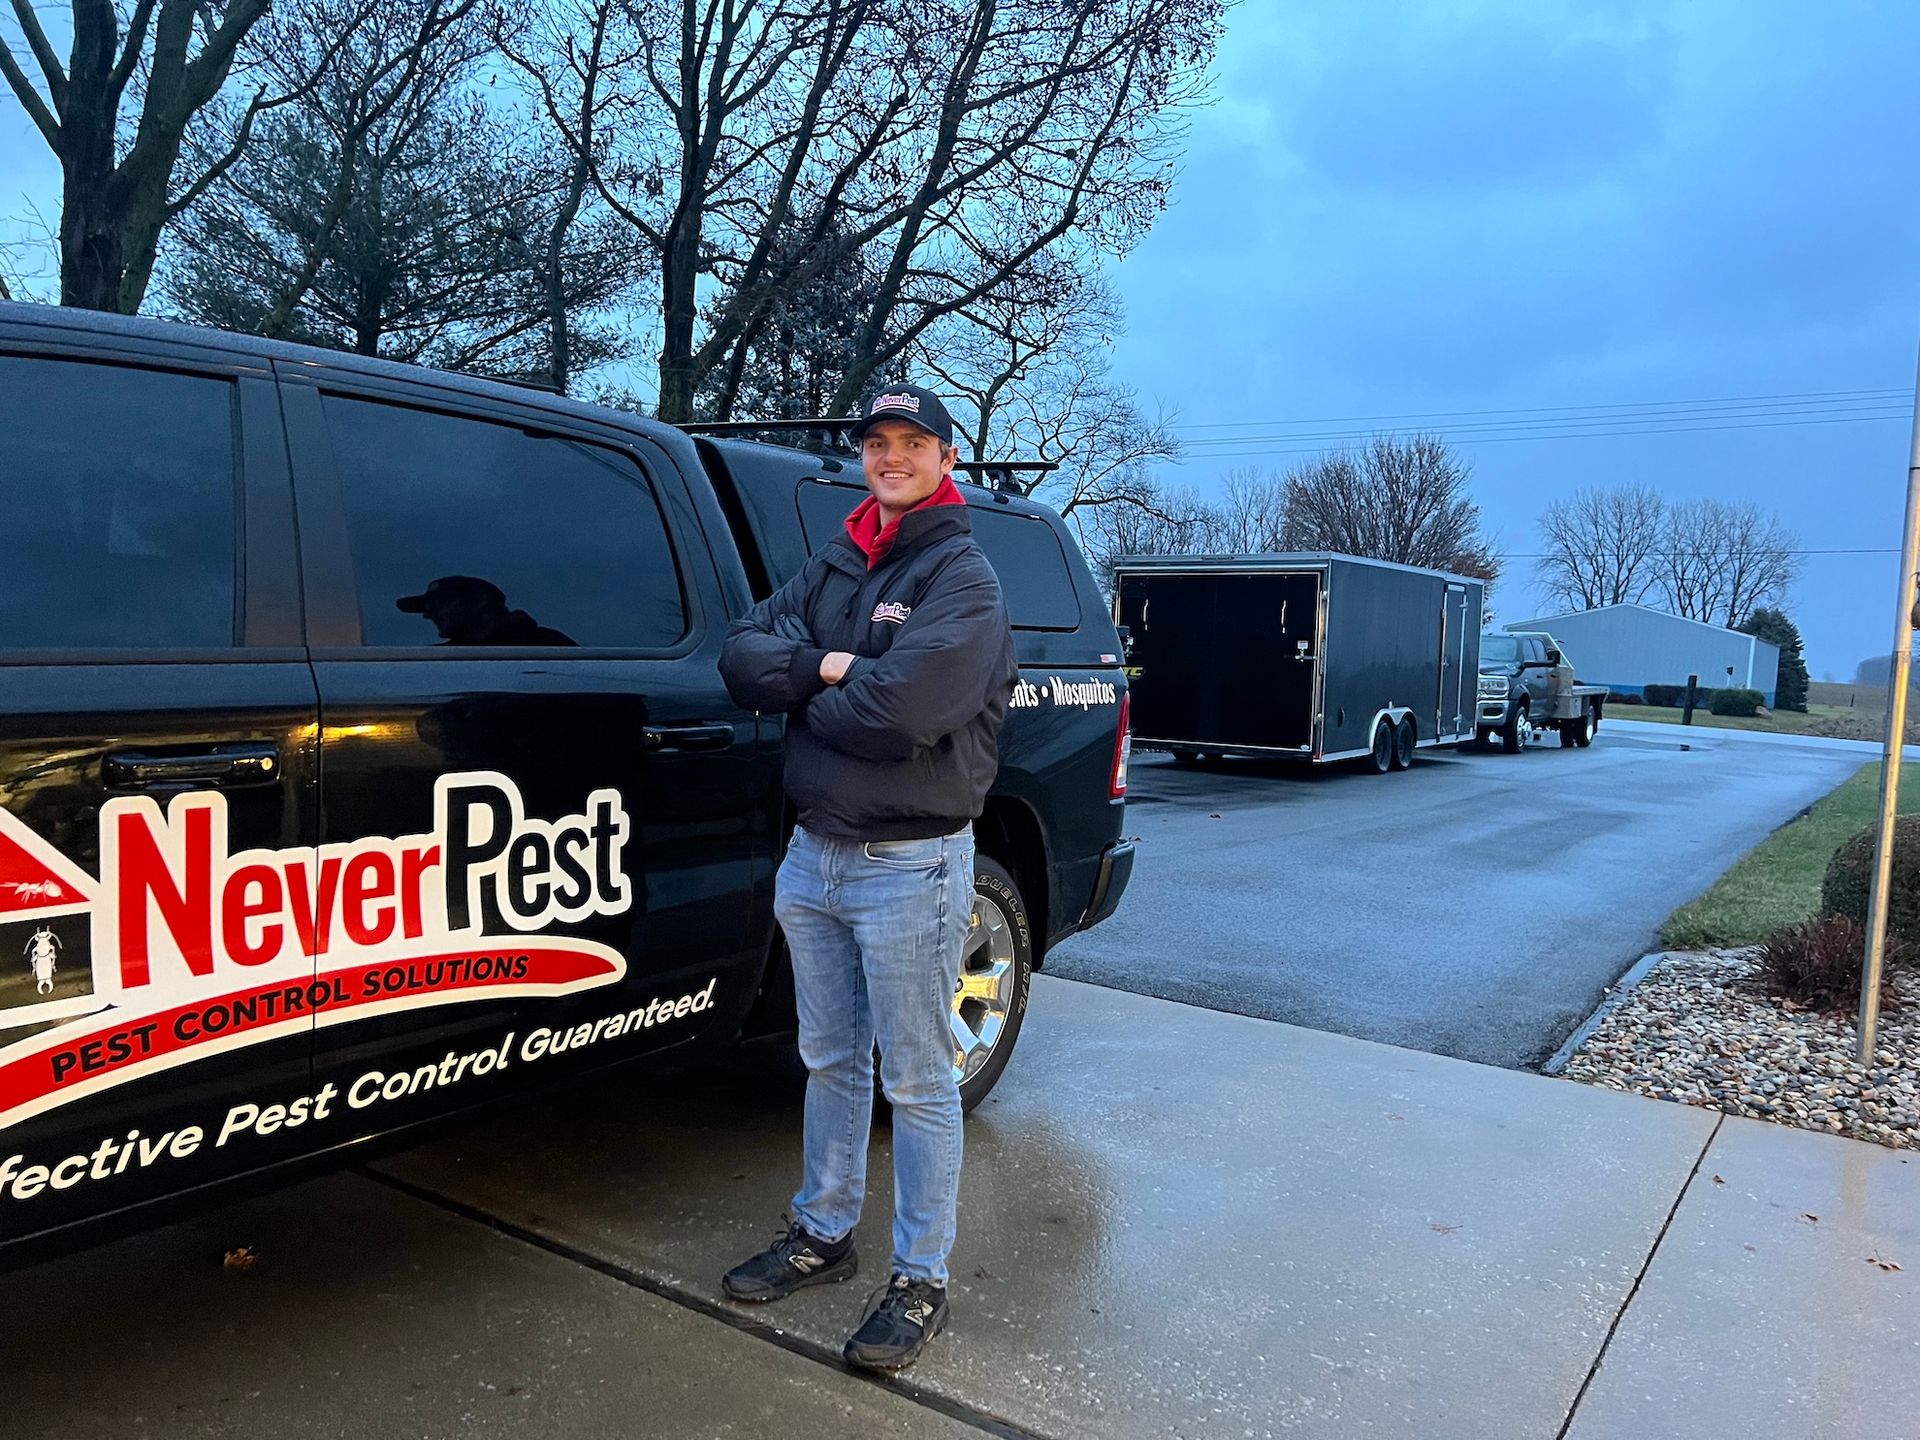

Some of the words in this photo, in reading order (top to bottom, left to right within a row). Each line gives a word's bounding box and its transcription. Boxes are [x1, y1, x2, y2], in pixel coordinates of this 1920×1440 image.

[1049, 676, 1117, 712] Mosquitos
[117, 784, 623, 990] NeverPest
[976, 874, 1029, 947] DUELER
[50, 1022, 158, 1084] PEST
[173, 981, 350, 1041] CONTROL
[361, 954, 530, 997] SOLUTIONS
[215, 1083, 338, 1148] Pest
[346, 1046, 511, 1111] Control
[520, 979, 715, 1058] Guaranteed.
